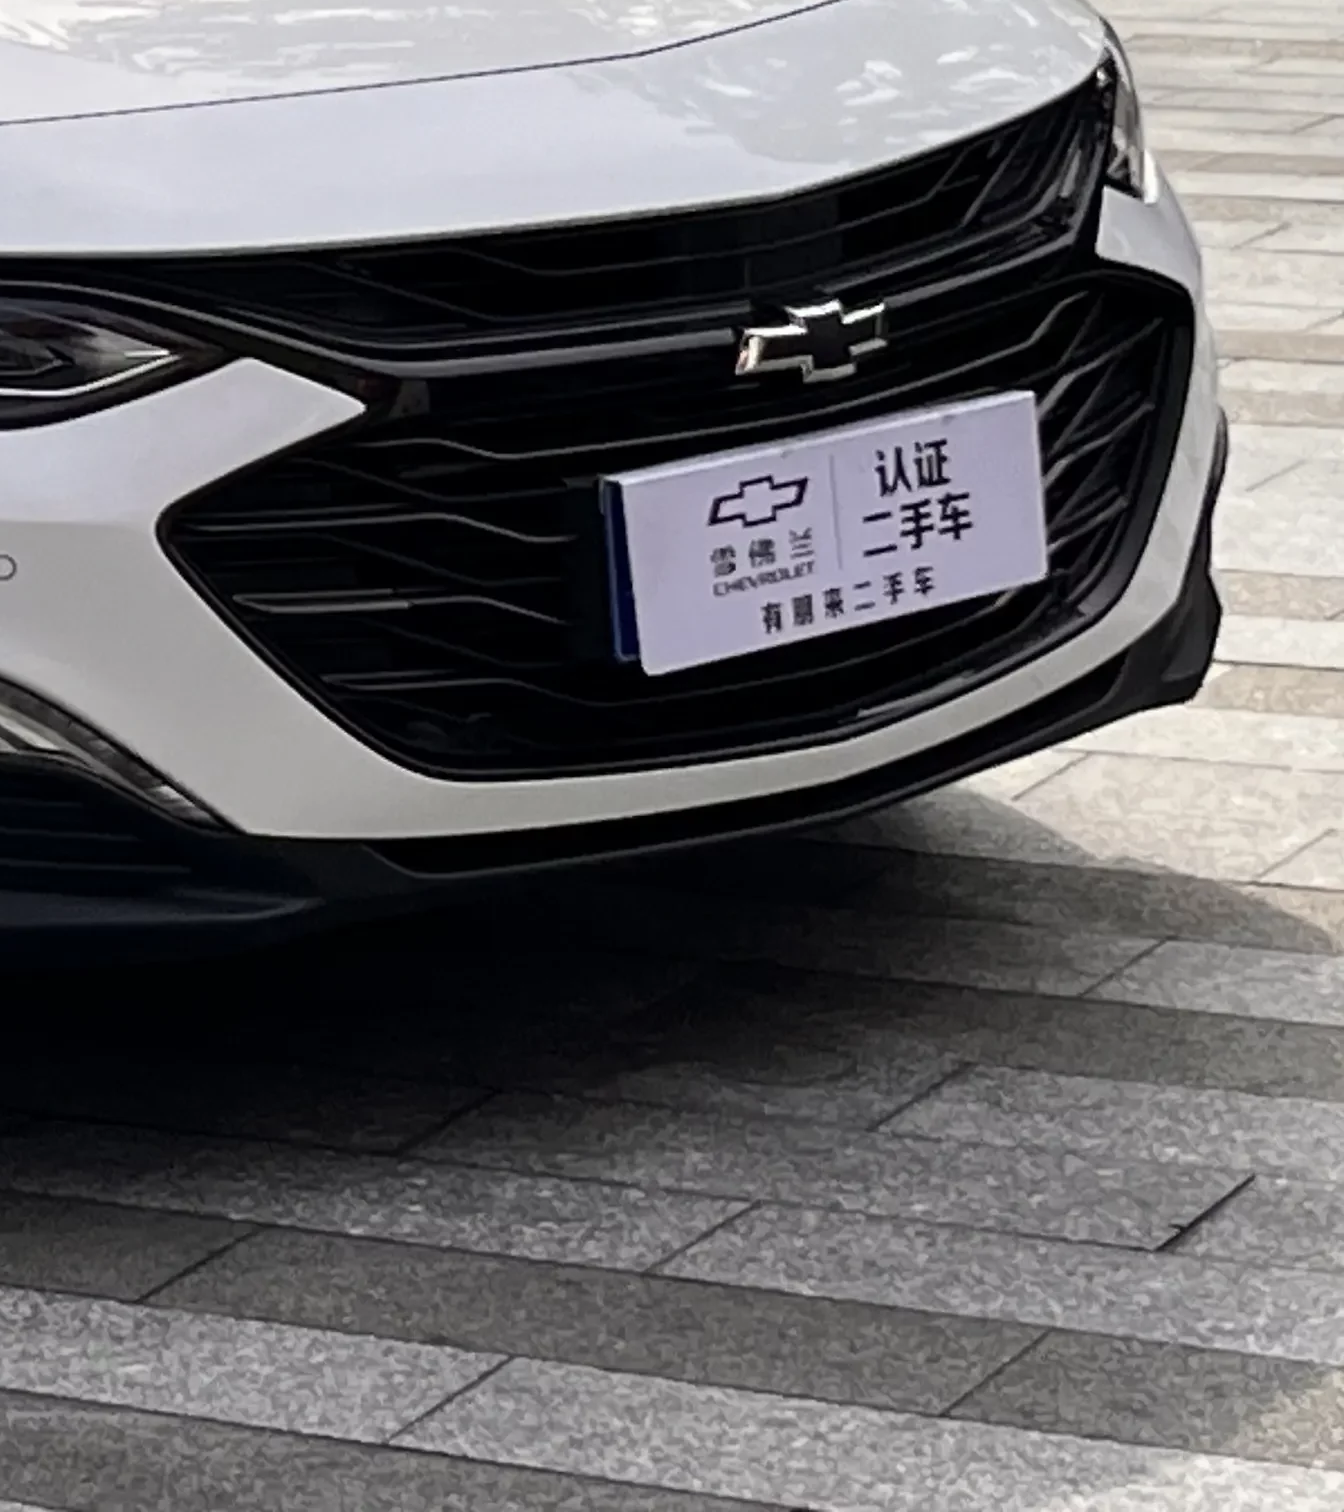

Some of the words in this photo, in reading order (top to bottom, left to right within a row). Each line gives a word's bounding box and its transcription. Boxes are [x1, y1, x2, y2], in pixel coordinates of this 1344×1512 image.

[874, 438, 952, 497] 认证
[710, 526, 815, 578] 雪佛兰
[862, 491, 973, 558] 二手车
[712, 560, 815, 598] CHEVROLET
